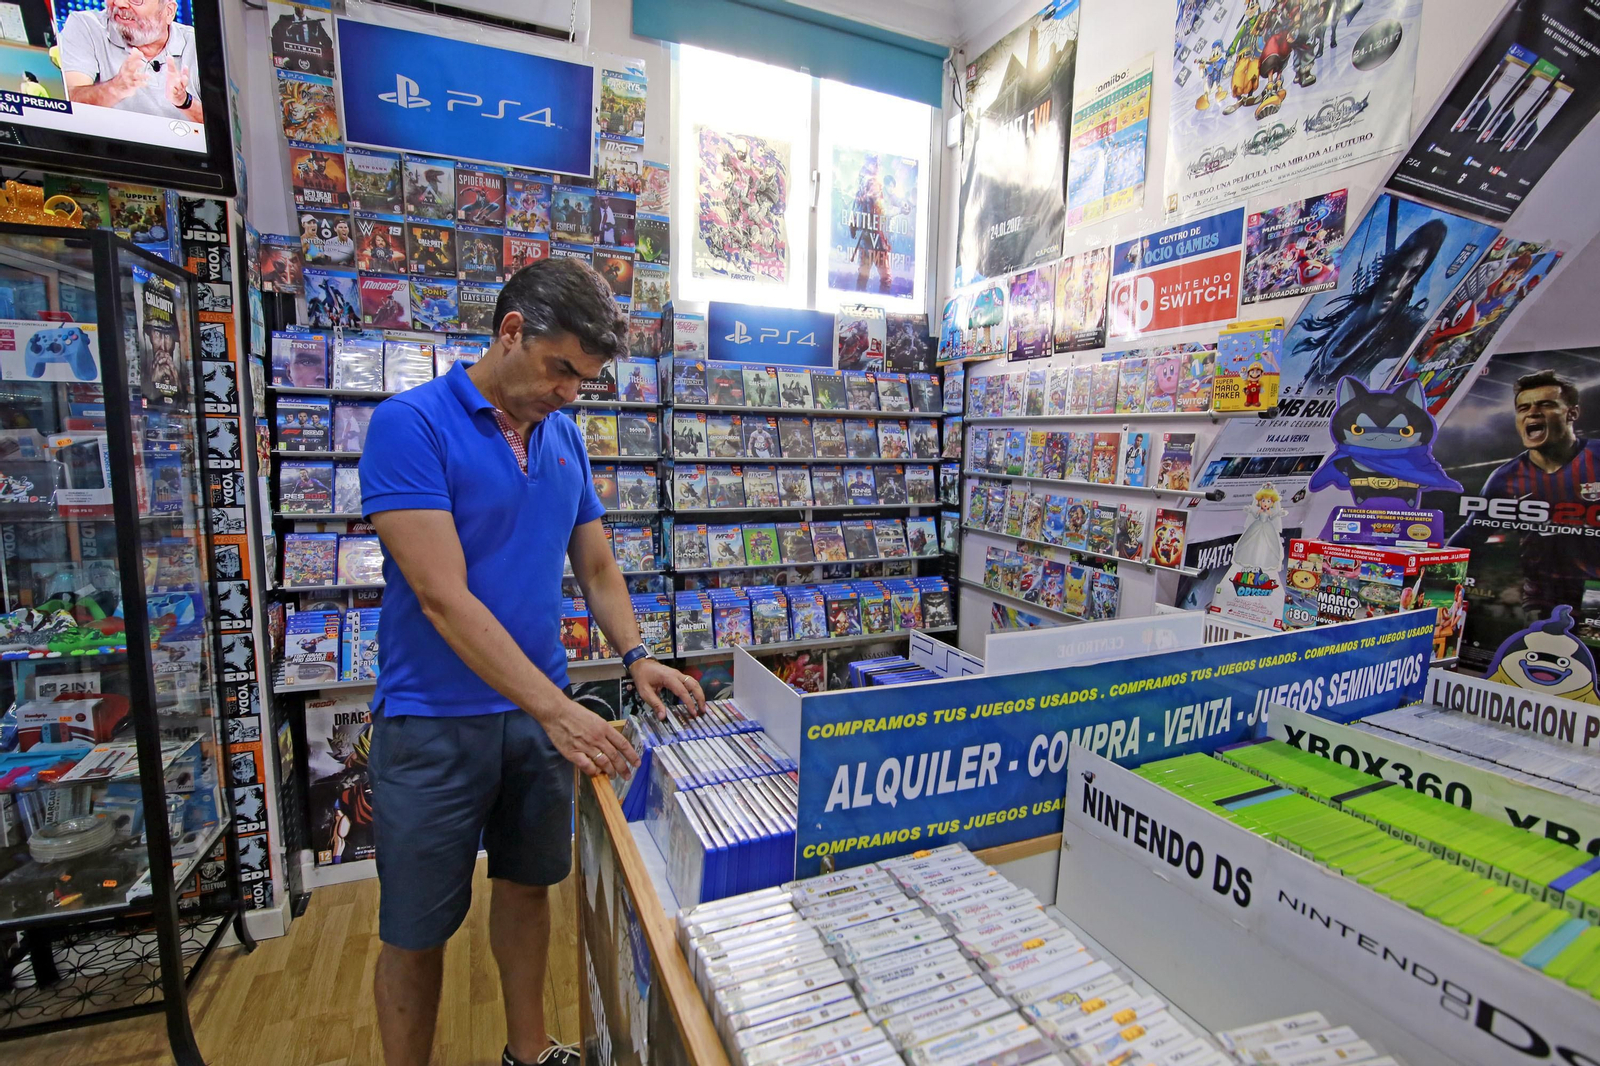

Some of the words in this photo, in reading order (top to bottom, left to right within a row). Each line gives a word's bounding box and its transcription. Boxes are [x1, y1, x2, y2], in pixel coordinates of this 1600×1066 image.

[1353, 31, 1401, 59] 24.1.2017
[1097, 71, 1126, 93] amiibo
[5, 93, 21, 103] SU
[23, 96, 68, 111] PREMIO
[447, 90, 555, 127] PS4
[605, 142, 638, 153] MXGP
[1216, 181, 1231, 190] UNA
[1270, 163, 1286, 172] UNA
[1287, 150, 1321, 169] MIRADA
[1322, 145, 1334, 155] AL
[1335, 132, 1375, 151] FUTURO.
[458, 174, 500, 189] SPIDER-MAN
[841, 209, 908, 236] BATTLEFIELD
[183, 230, 227, 243] JEDI
[1159, 230, 1188, 245] CENTRO
[1189, 226, 1202, 236] DE
[1035, 245, 1059, 257] CAPCOM
[1144, 246, 1173, 265] OCIO
[1176, 232, 1219, 254] GAMES
[208, 247, 221, 281] YODA
[422, 288, 447, 296] SONIC
[1160, 272, 1232, 294] NINTENDO
[1251, 288, 1299, 302] MULTIJUGADOR
[1300, 281, 1335, 295] DEFINITIVO
[463, 293, 480, 302] DAYS
[1159, 282, 1231, 311] SWITCH
[760, 327, 817, 347] PS4
[1214, 384, 1240, 393] MARIO
[1214, 391, 1240, 400] MAKER
[1316, 388, 1335, 396] OF
[205, 404, 238, 414] EDI
[1288, 435, 1310, 443] VENTA
[221, 472, 235, 505] YODA
[1459, 496, 1550, 523] PES
[1472, 518, 1500, 529] PRO
[1501, 520, 1583, 536] EVOLUTION
[1351, 549, 1376, 557] SOBREMESA
[1236, 586, 1274, 597] ODYSSEY
[1326, 585, 1350, 596] SUPER
[1317, 592, 1360, 609] MARIO
[1319, 603, 1356, 618] PARTY
[220, 619, 252, 630] EDI
[807, 711, 927, 741] COMPRAMOS
[933, 706, 967, 725] TUS
[970, 696, 1036, 720] JUEGOS
[1039, 687, 1098, 709] USADOS
[1109, 672, 1187, 698] COMPRAMOS
[1191, 668, 1213, 682] TUS
[1214, 659, 1256, 677] JUEGOS
[1259, 652, 1297, 669] USADOS
[1305, 640, 1358, 660] COMPRAMOS
[1360, 636, 1376, 650] TUS
[1376, 630, 1406, 647] JUEGOS
[1406, 624, 1434, 640] USADOS
[237, 683, 250, 715] YODA
[1432, 679, 1576, 745] LIQUIDACION
[824, 742, 1001, 813] ALQUILER
[1164, 697, 1232, 748] VENTA
[1247, 676, 1323, 727] JUEGOS
[1326, 653, 1424, 707] SEMINUEVOS
[1283, 724, 1473, 811] XBOX360
[802, 827, 921, 860] COMPRAMOS
[927, 818, 960, 837] TUS
[963, 806, 1027, 830] JUEGOS
[1032, 797, 1066, 816] USA
[1082, 782, 1204, 880] NINTENDO
[1212, 854, 1253, 908] DS
[319, 852, 331, 861] 12
[1278, 889, 1473, 1006] NINTENDO
